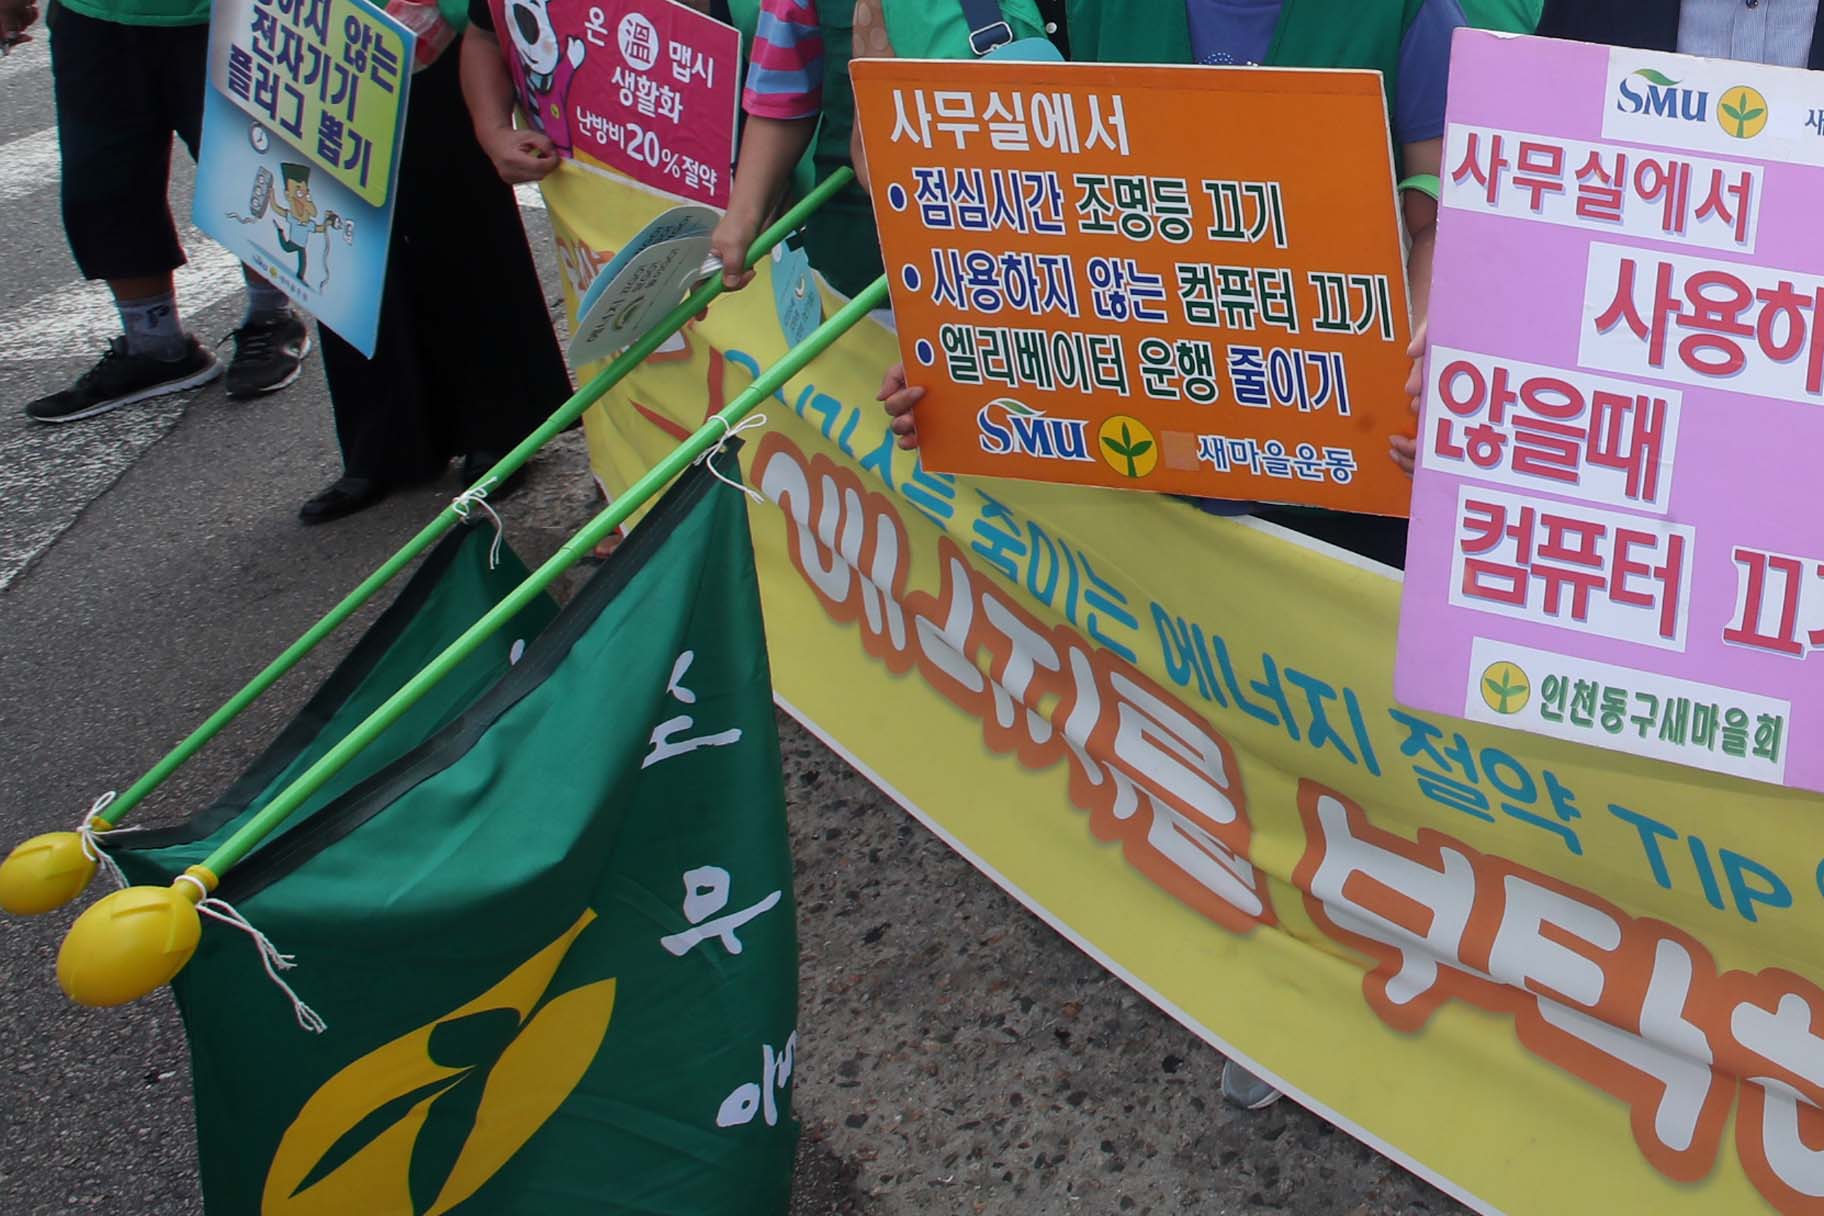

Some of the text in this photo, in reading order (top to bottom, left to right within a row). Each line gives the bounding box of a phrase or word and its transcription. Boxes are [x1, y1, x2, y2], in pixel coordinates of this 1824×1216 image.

[251, 4, 359, 122] 전자기기
[344, 15, 398, 93] 않는
[584, 6, 608, 47] 온
[668, 40, 714, 89] 맵시
[228, 44, 373, 188] 플러그 뽑기
[611, 66, 683, 124] 생활화
[889, 88, 1130, 155] 사무실에서
[1616, 70, 1710, 125] SMU
[912, 167, 1289, 250] 점심시간 조명등 끄기
[1450, 130, 1753, 243] 사무실에서
[930, 250, 1396, 343] 사용하지 않는 컴퓨터 끄기
[938, 324, 1352, 417] 엘리베이터 운행 줄이기
[977, 398, 1358, 484] SMU 새마을운동
[1434, 357, 1666, 503] 않을때
[1459, 498, 1687, 637] 컴퓨터
[1539, 672, 1785, 765] 인천동구새마을회
[1162, 613, 1381, 782] 에너지
[1391, 705, 1585, 857] 절약
[1606, 801, 1796, 926] TIP
